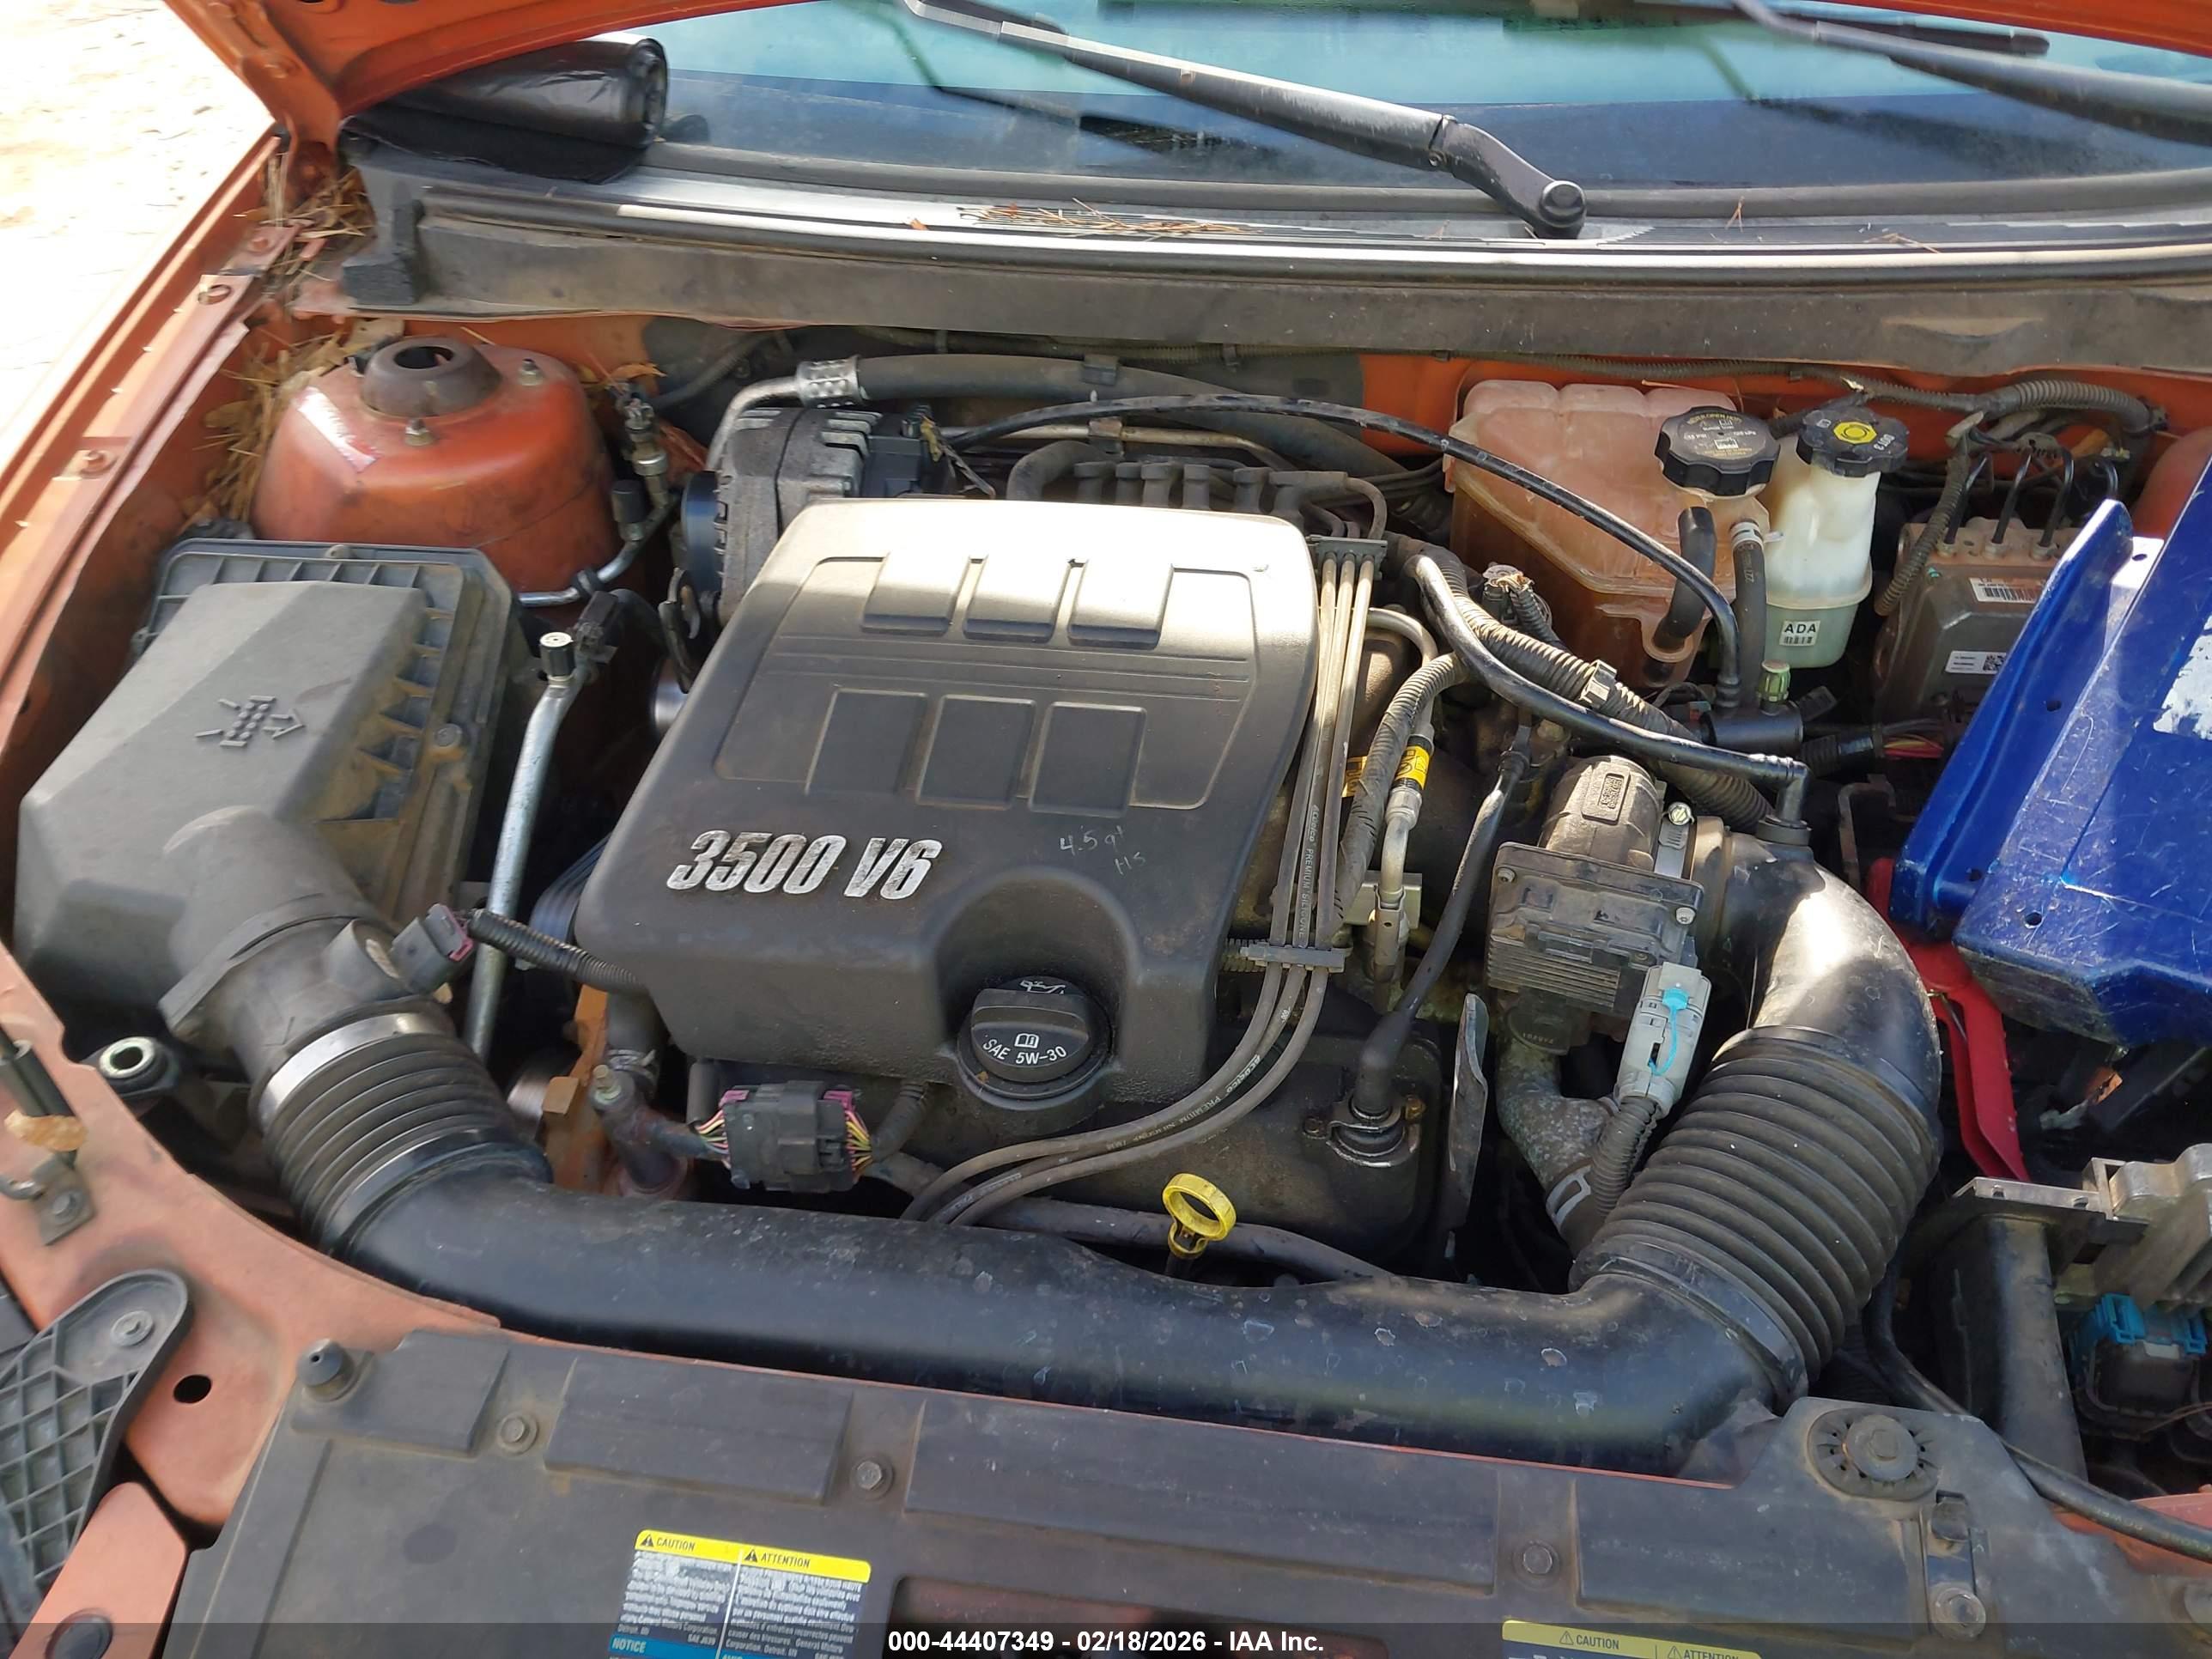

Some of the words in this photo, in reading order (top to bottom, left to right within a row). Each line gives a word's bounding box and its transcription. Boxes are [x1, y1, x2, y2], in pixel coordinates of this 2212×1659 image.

[1784, 623, 1816, 634] ADA
[666, 830, 846, 895] 3500
[843, 838, 943, 900] V6
[1302, 848, 1313, 889] PREMIUM
[981, 1038, 1010, 1061] SAE
[1016, 1044, 1067, 1066] 5W-30
[656, 1536, 696, 1552] CAUTION
[761, 1553, 811, 1569] ATTENTION
[612, 1637, 647, 1654] NOTICE
[1576, 1634, 1620, 1650] CAUTION
